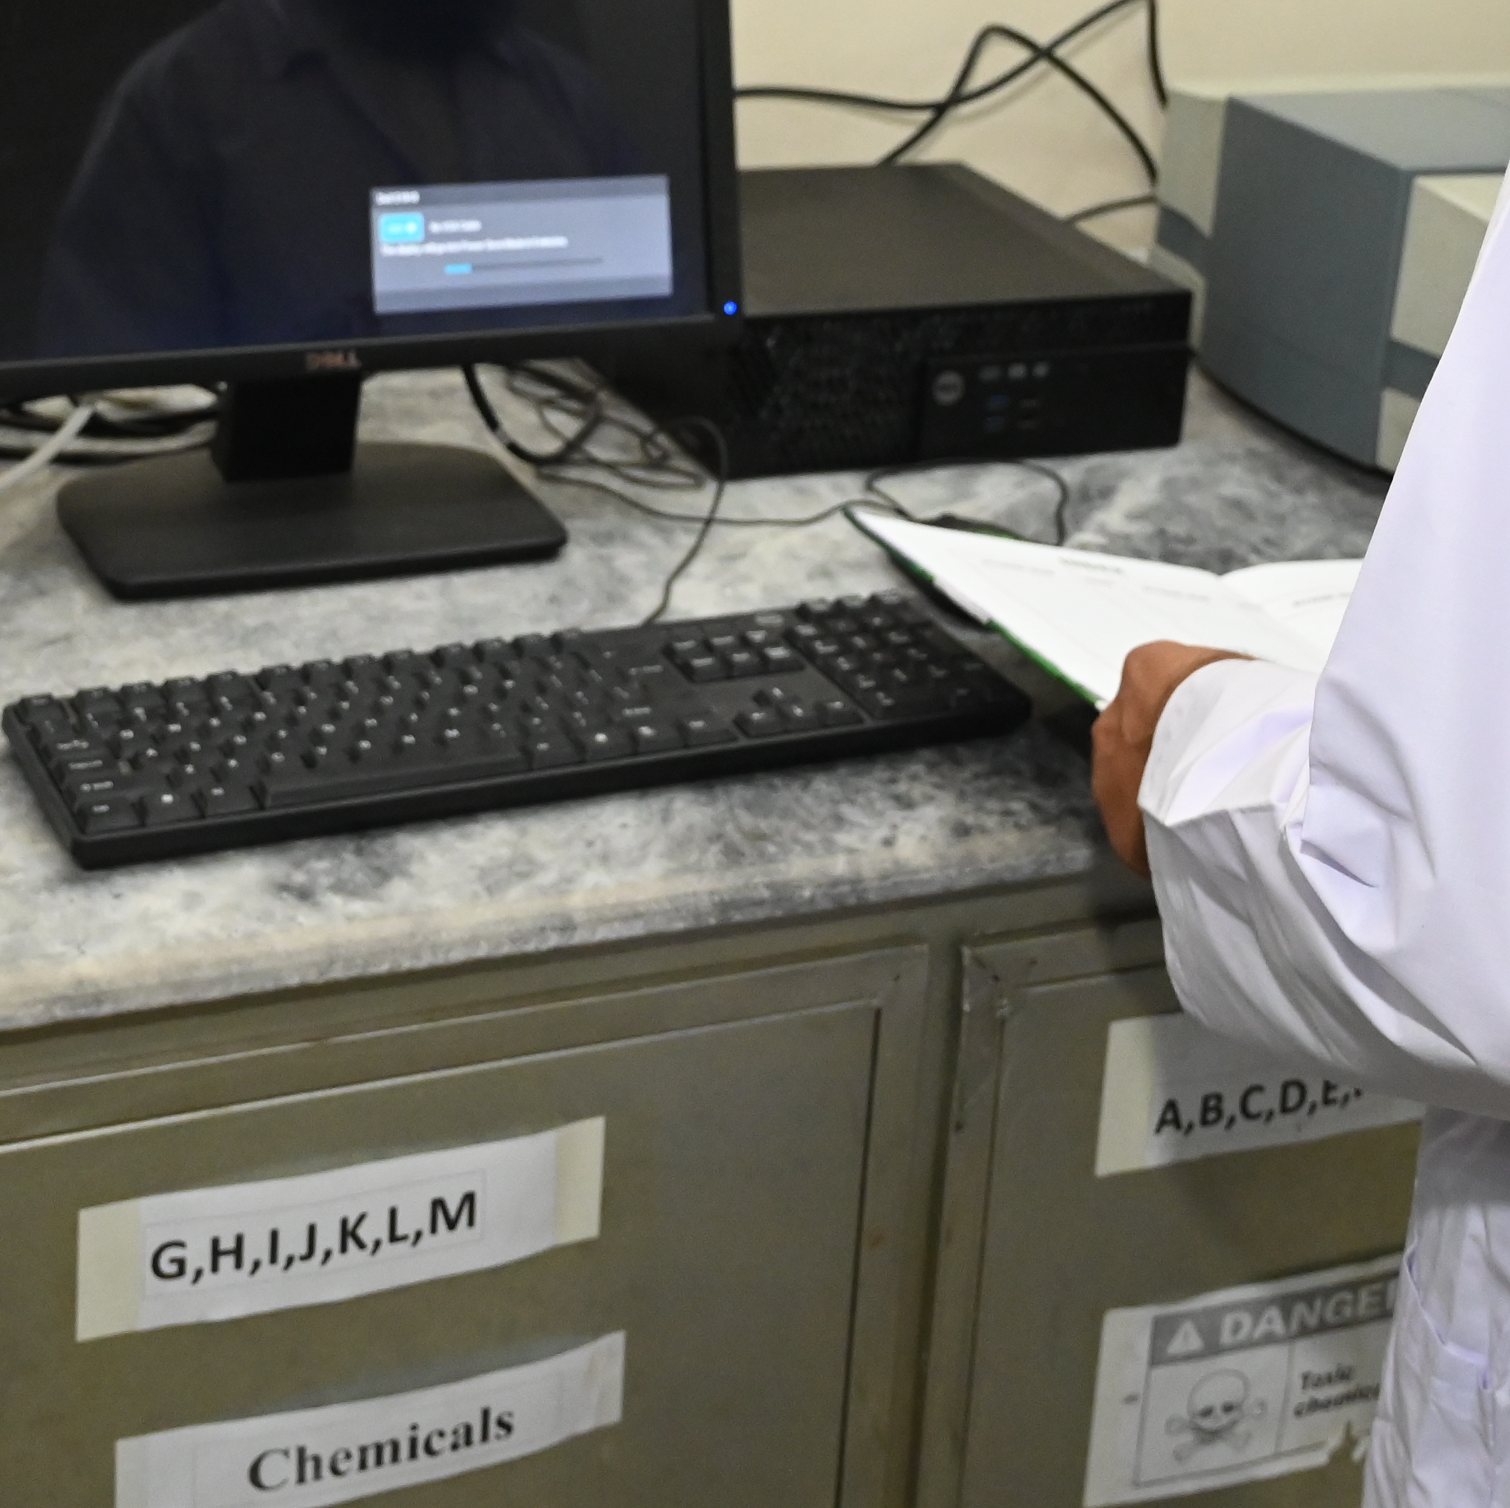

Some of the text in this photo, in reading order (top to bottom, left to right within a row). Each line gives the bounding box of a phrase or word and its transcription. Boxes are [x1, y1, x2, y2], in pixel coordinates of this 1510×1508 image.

[1154, 1078, 1364, 1136] A,B,C,D,E,
[150, 1190, 478, 1285] G,H,I,J,K,L,M
[247, 1406, 516, 1493] Chemicals
